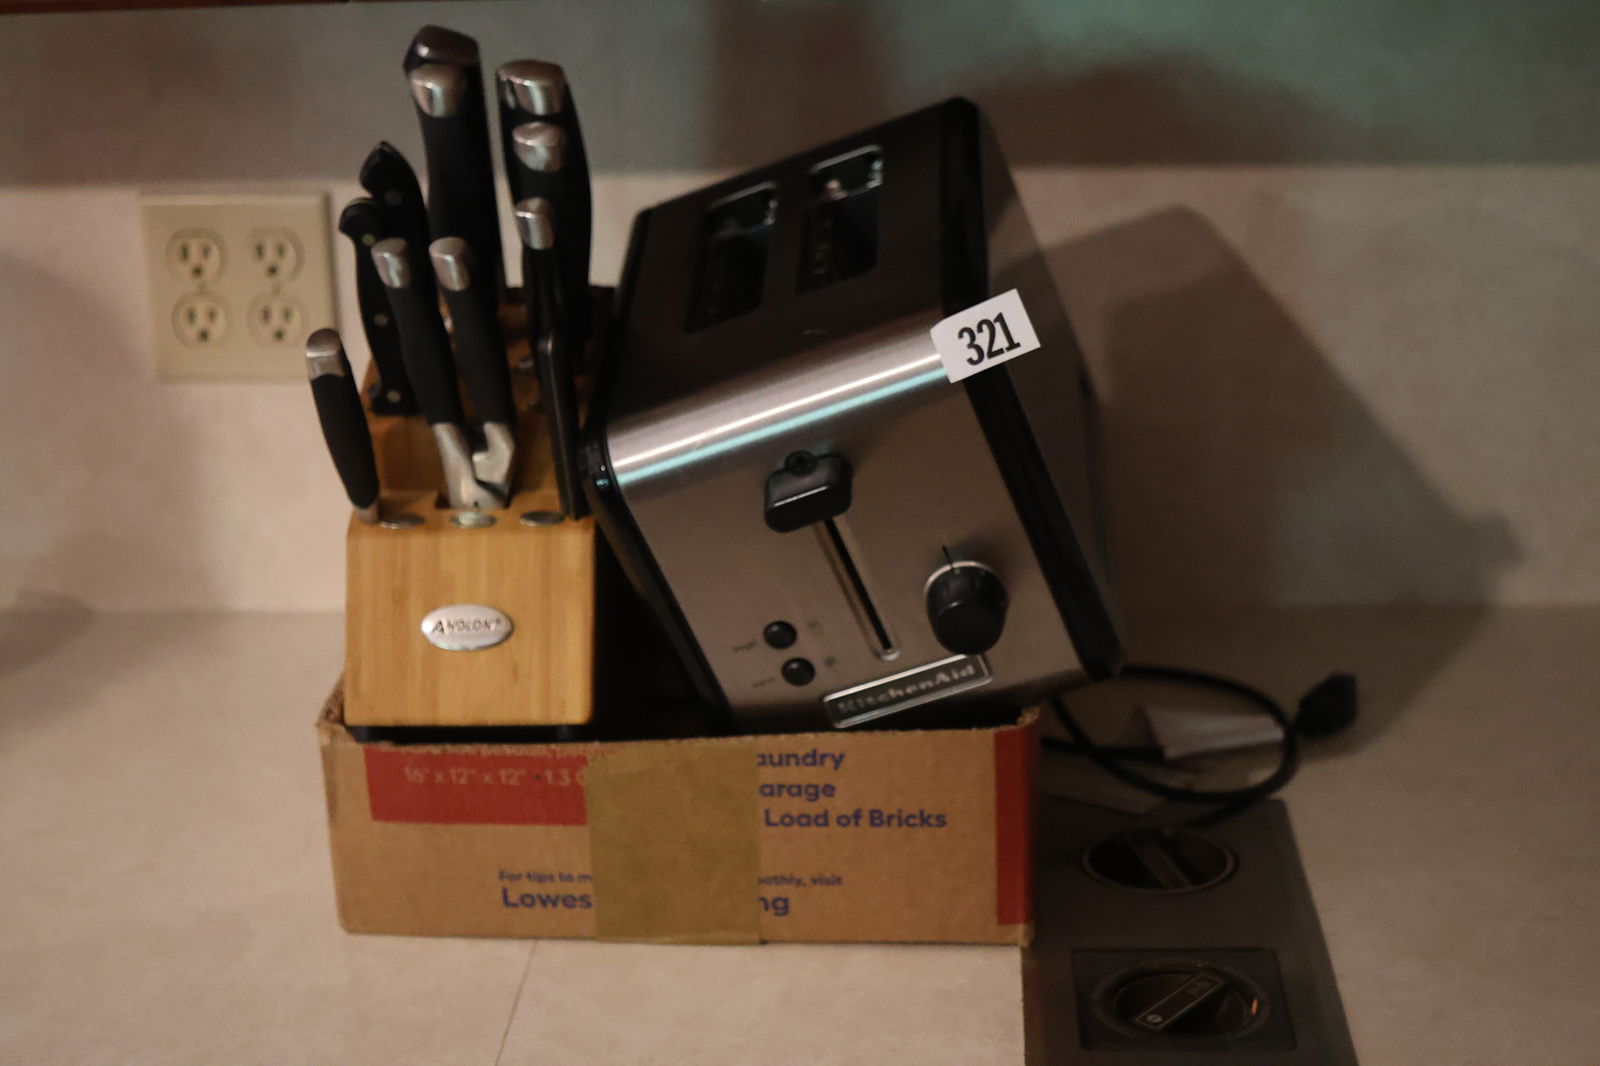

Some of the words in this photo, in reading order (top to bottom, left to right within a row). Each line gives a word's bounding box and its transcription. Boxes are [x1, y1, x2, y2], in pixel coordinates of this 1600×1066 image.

[958, 312, 1022, 366] 321
[837, 664, 976, 713] KitchenAid
[765, 809, 829, 828] Load
[836, 809, 862, 828] of
[869, 809, 948, 828] Bricks
[499, 869, 523, 882] For
[558, 871, 575, 883] to
